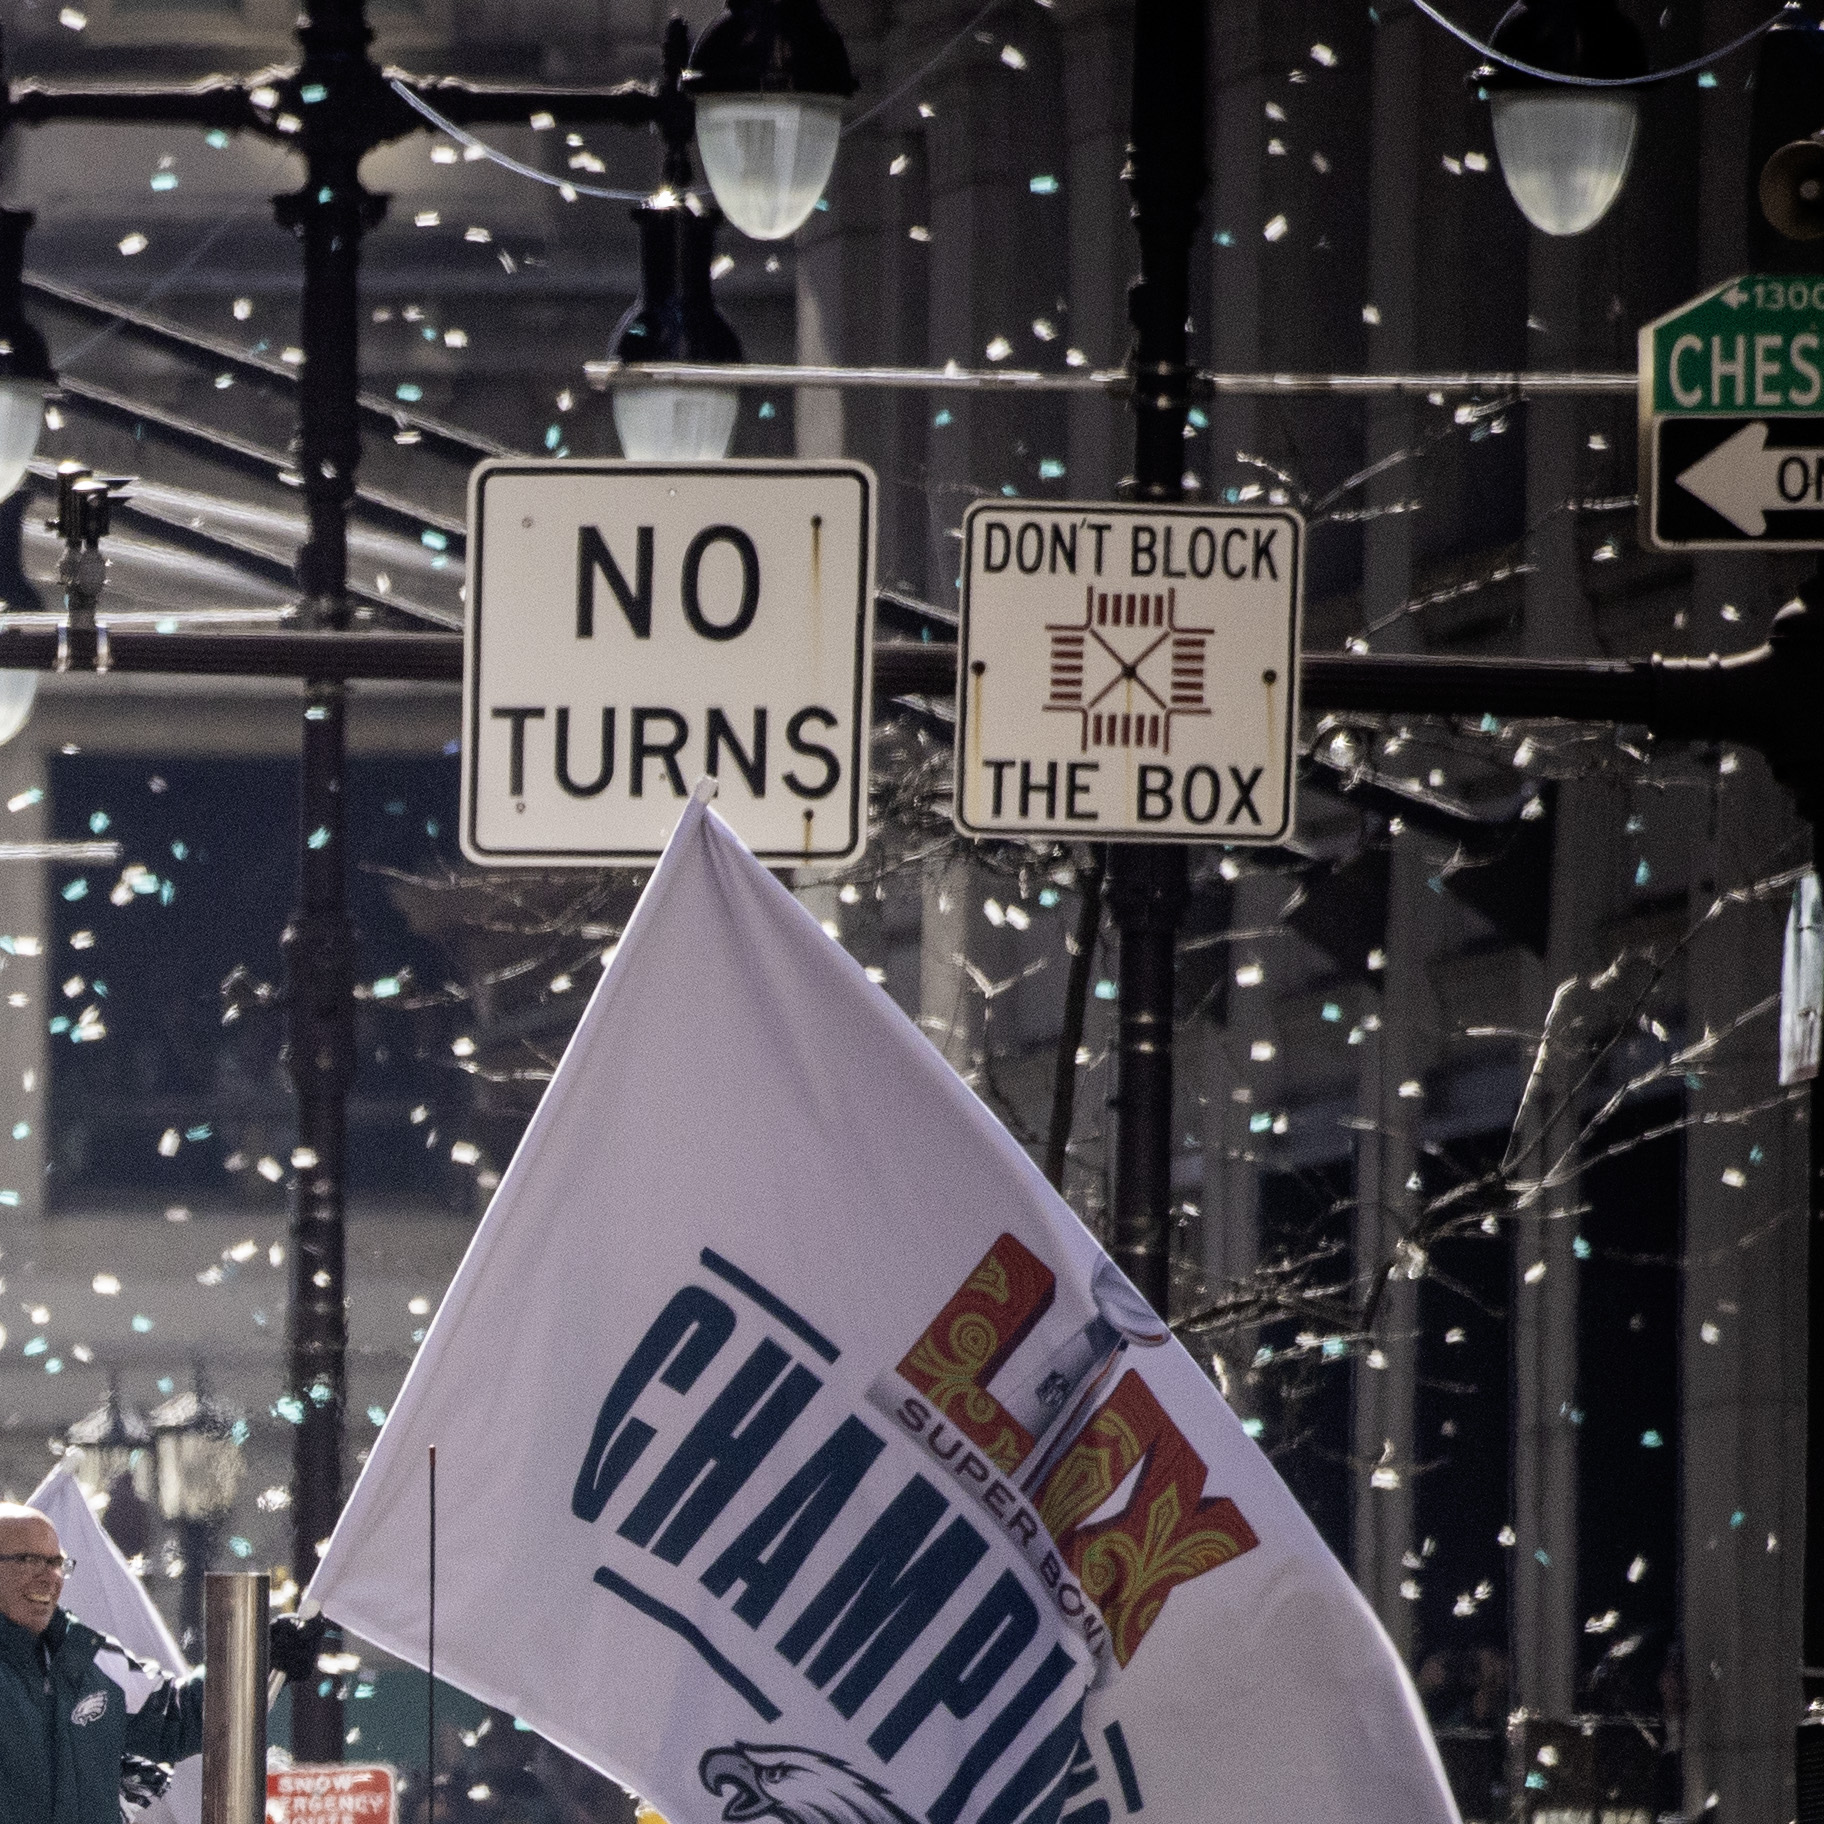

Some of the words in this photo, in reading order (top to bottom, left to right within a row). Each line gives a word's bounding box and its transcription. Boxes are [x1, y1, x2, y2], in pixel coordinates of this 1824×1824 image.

[576, 524, 761, 641] NO
[984, 522, 1111, 577] DON'T
[1131, 525, 1280, 580] BLOCK
[491, 706, 842, 800] TURNS
[983, 760, 1100, 822] THE
[1136, 765, 1265, 826] BOX
[897, 1397, 1039, 1549] SUPER
[278, 1774, 353, 1794] SNOW
